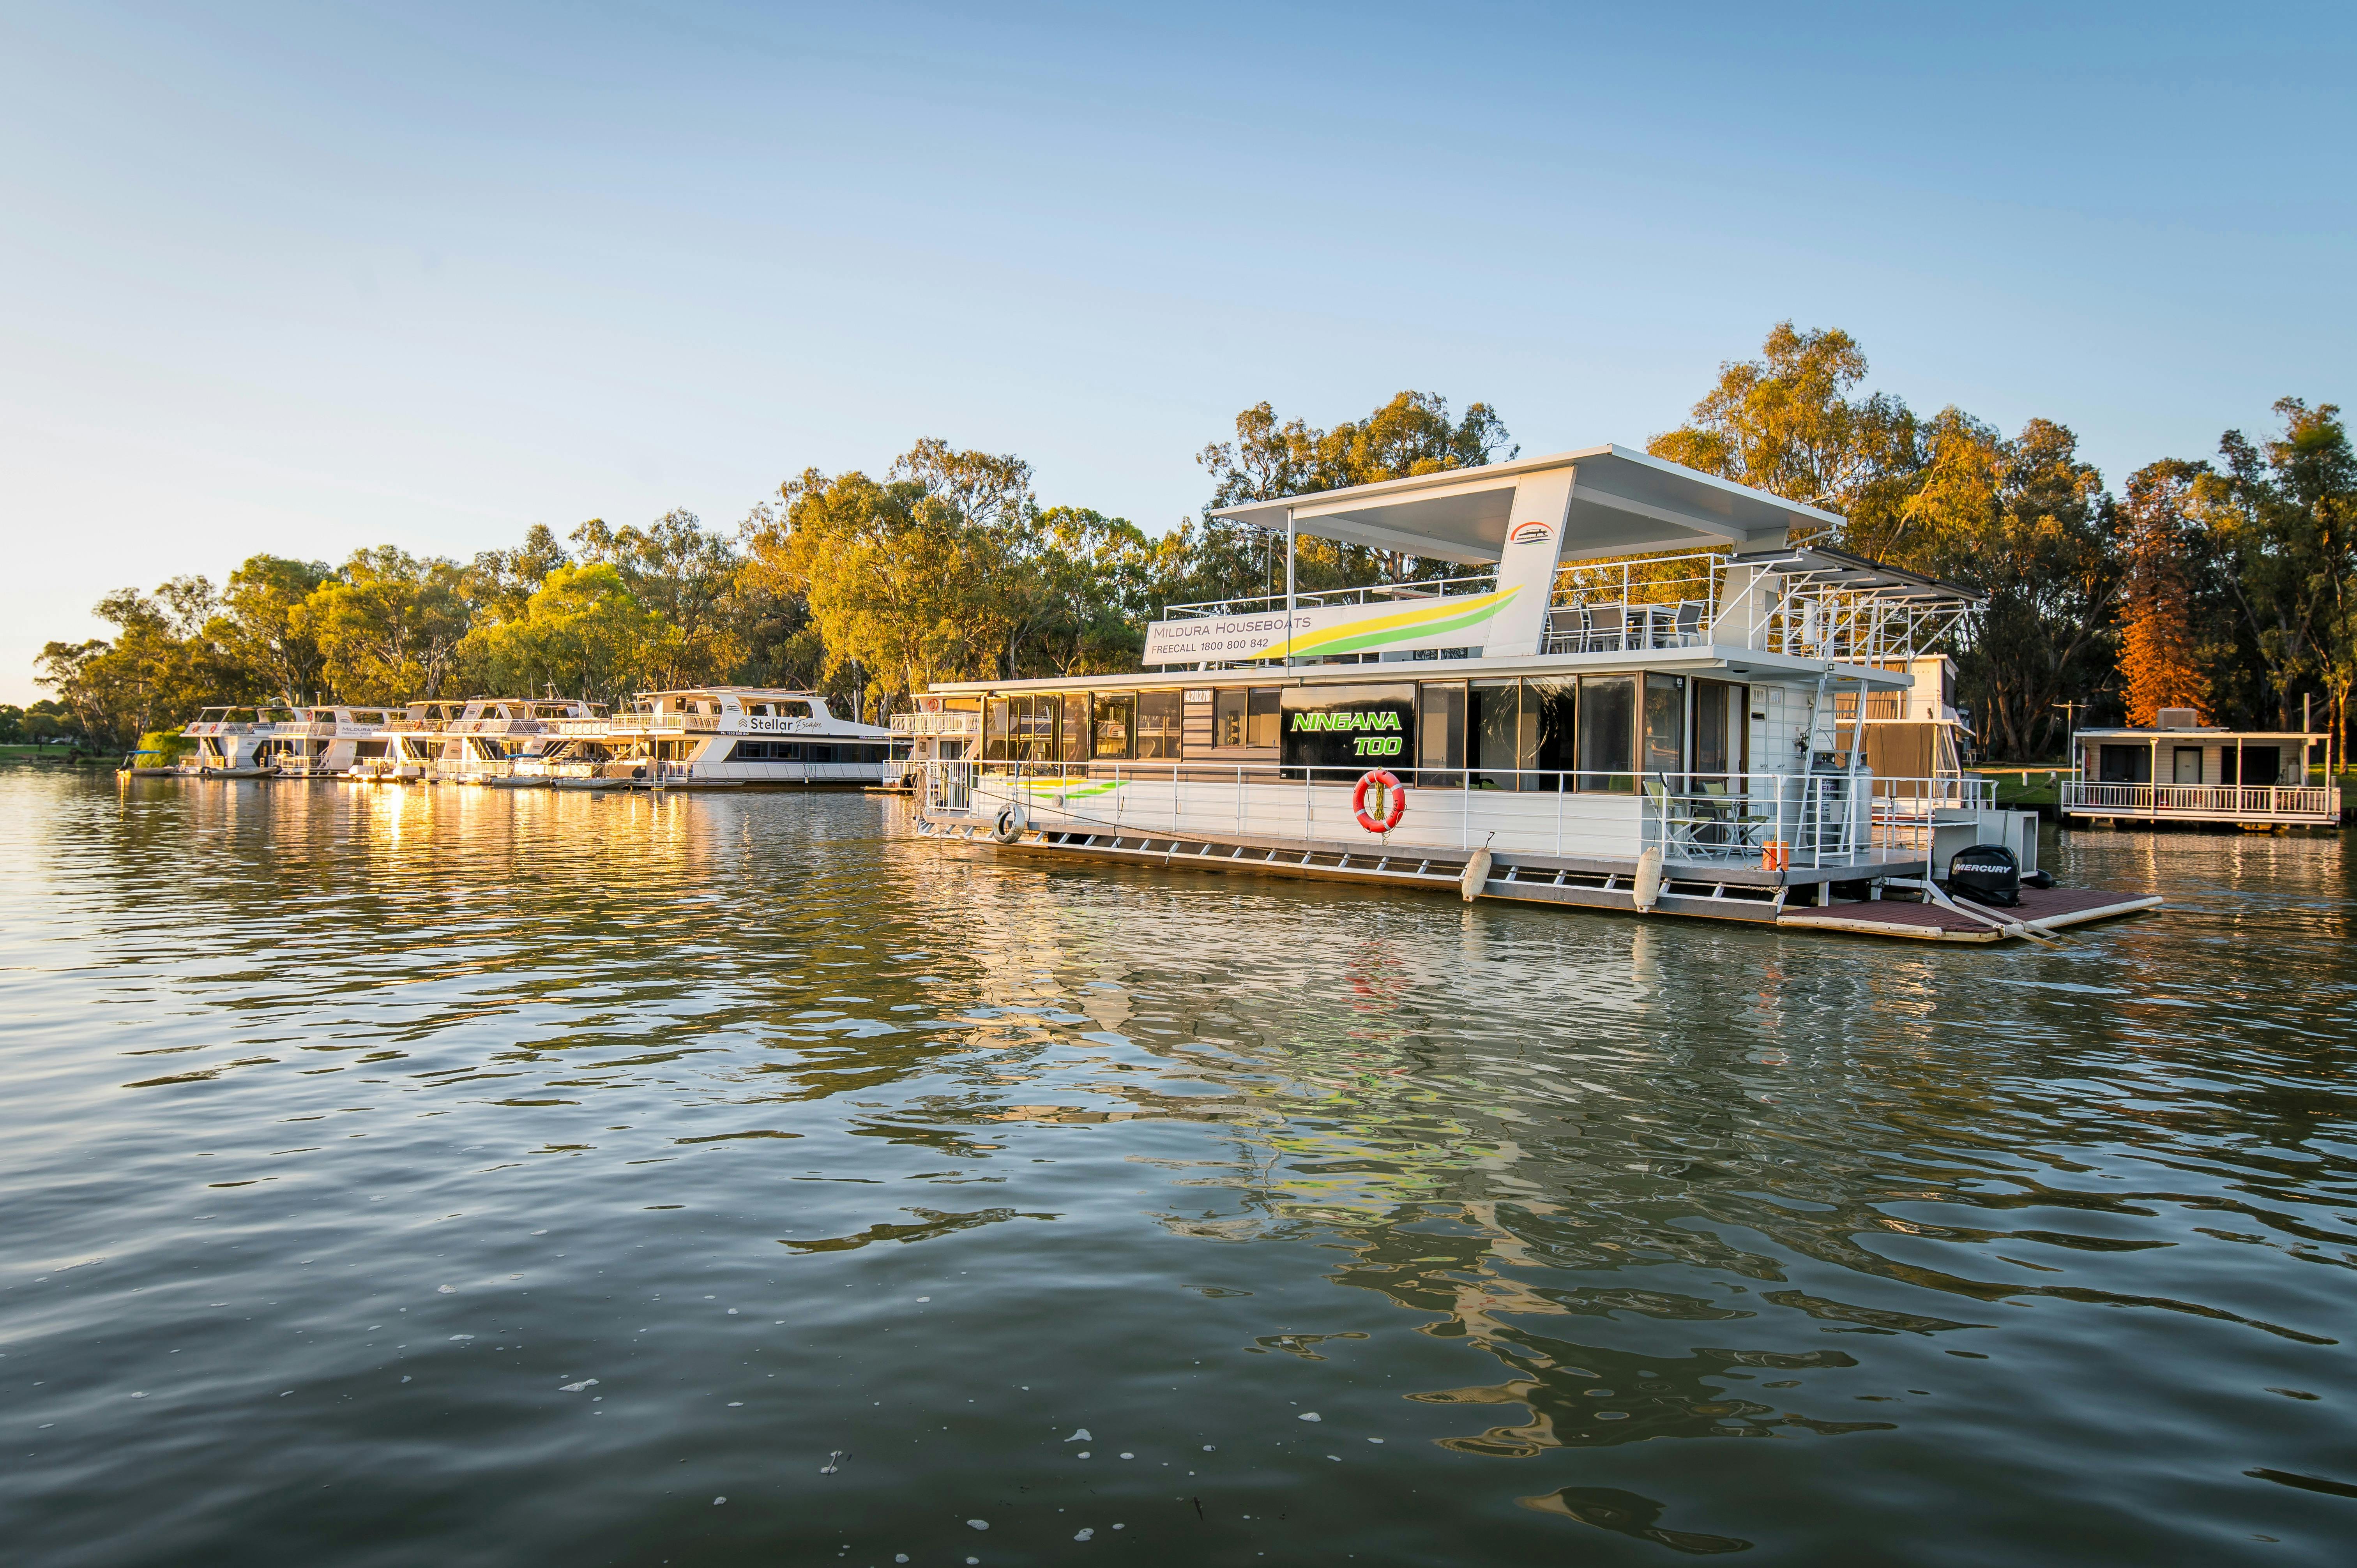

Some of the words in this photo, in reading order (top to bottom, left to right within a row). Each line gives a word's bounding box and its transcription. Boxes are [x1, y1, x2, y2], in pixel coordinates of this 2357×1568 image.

[1154, 625, 1210, 639] MILDURA
[1216, 617, 1311, 634] HOUSEBOATS
[1152, 643, 1196, 653] FREECALL
[1201, 641, 1223, 651] 1800
[1227, 640, 1246, 649] 800
[1250, 638, 1269, 648] 842
[1185, 690, 1210, 702] 420278
[751, 718, 793, 730] Stellar
[795, 718, 822, 733] Escape
[1290, 712, 1402, 731] NINGANA
[1353, 737, 1402, 755] TOO
[1390, 800, 1398, 818] 17641
[1954, 864, 2012, 873] MERCURY
